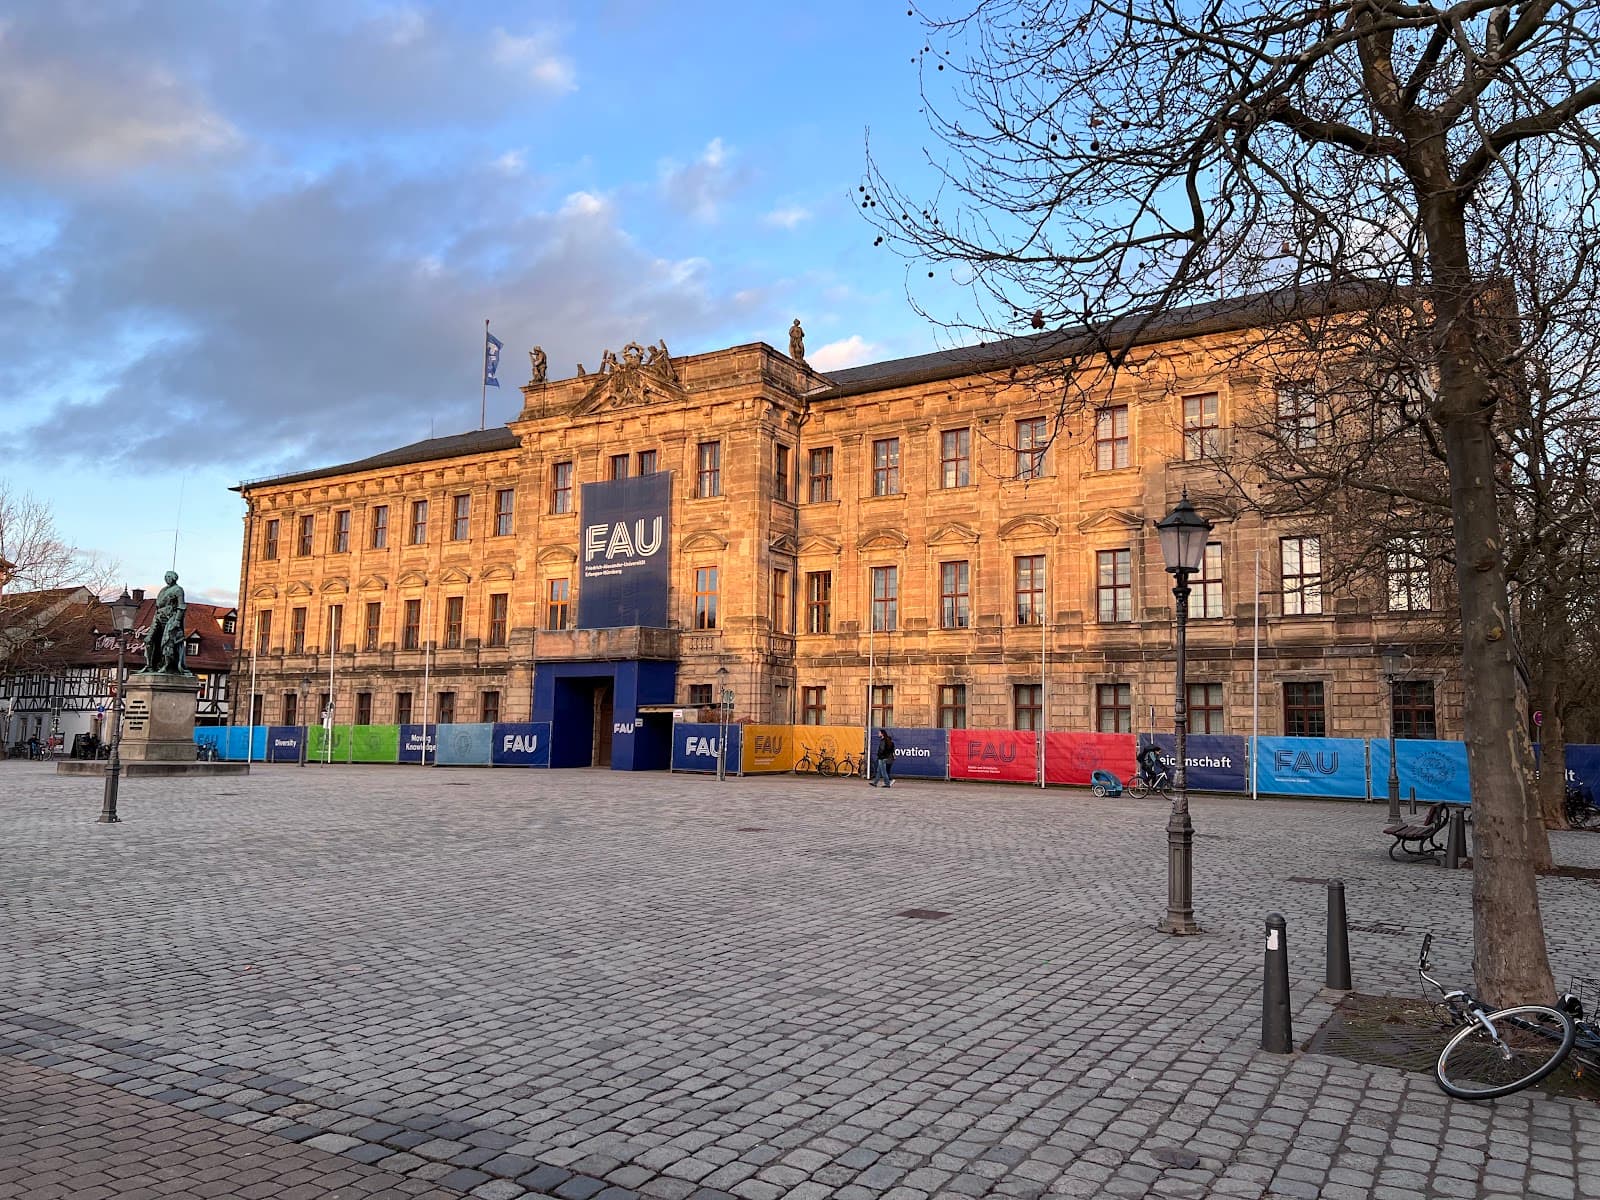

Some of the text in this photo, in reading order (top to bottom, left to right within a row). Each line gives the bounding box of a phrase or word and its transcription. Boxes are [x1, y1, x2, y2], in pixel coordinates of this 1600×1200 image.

[585, 516, 663, 562] FAU
[613, 722, 634, 734] FAU
[274, 738, 297, 748] Diversity
[503, 735, 537, 753] FAU
[686, 737, 724, 757] FAU
[754, 735, 782, 754] FAU
[894, 747, 931, 757] ovation
[967, 741, 1017, 762] FAU
[1274, 750, 1339, 775] FAU
